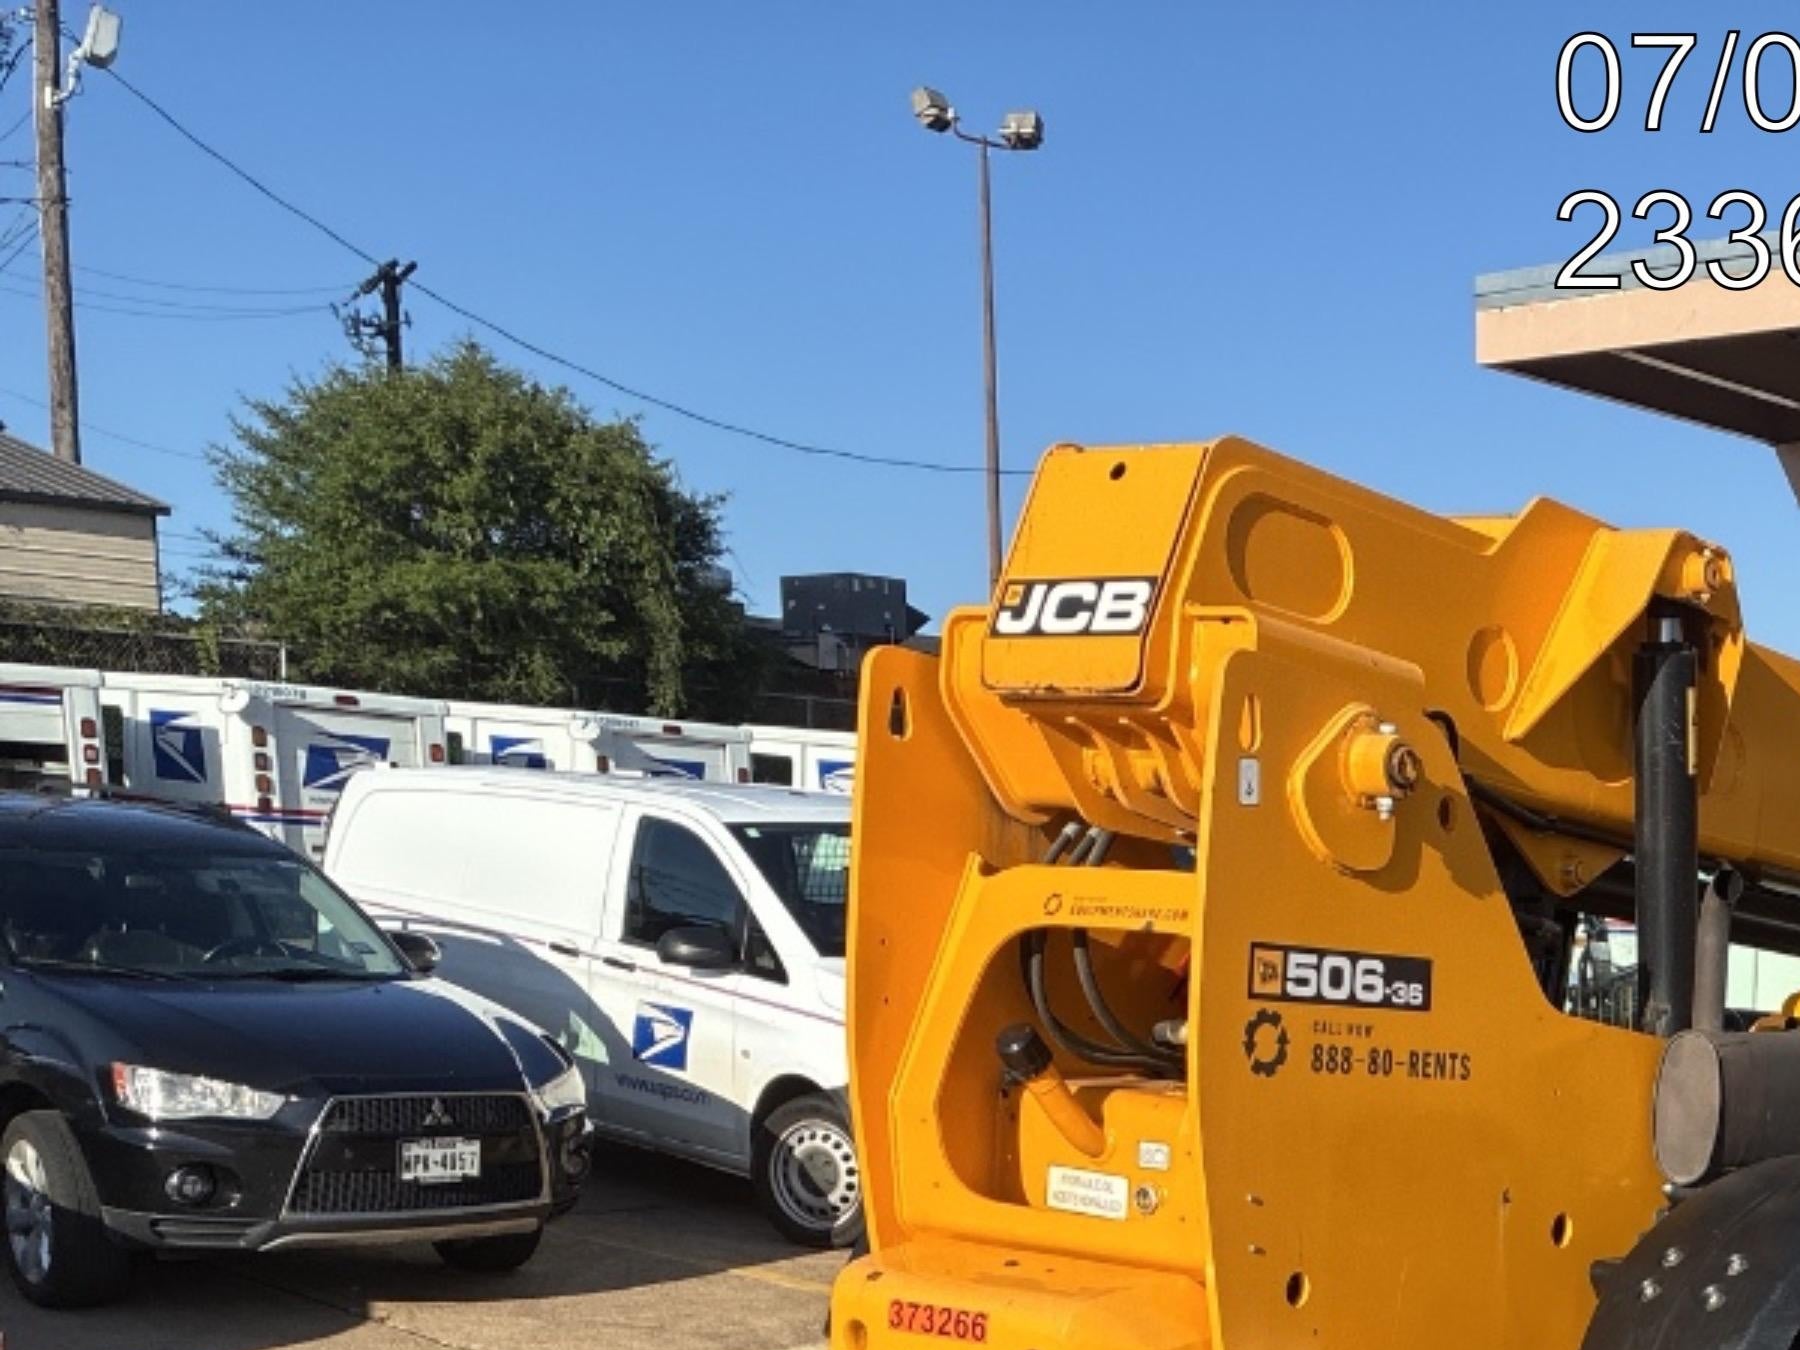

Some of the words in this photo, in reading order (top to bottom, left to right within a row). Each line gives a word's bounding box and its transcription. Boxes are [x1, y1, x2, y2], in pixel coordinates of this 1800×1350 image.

[995, 580, 1152, 634] JCB
[1311, 1042, 1472, 1082] 888-80-RENTS
[887, 1298, 989, 1344] 373266
